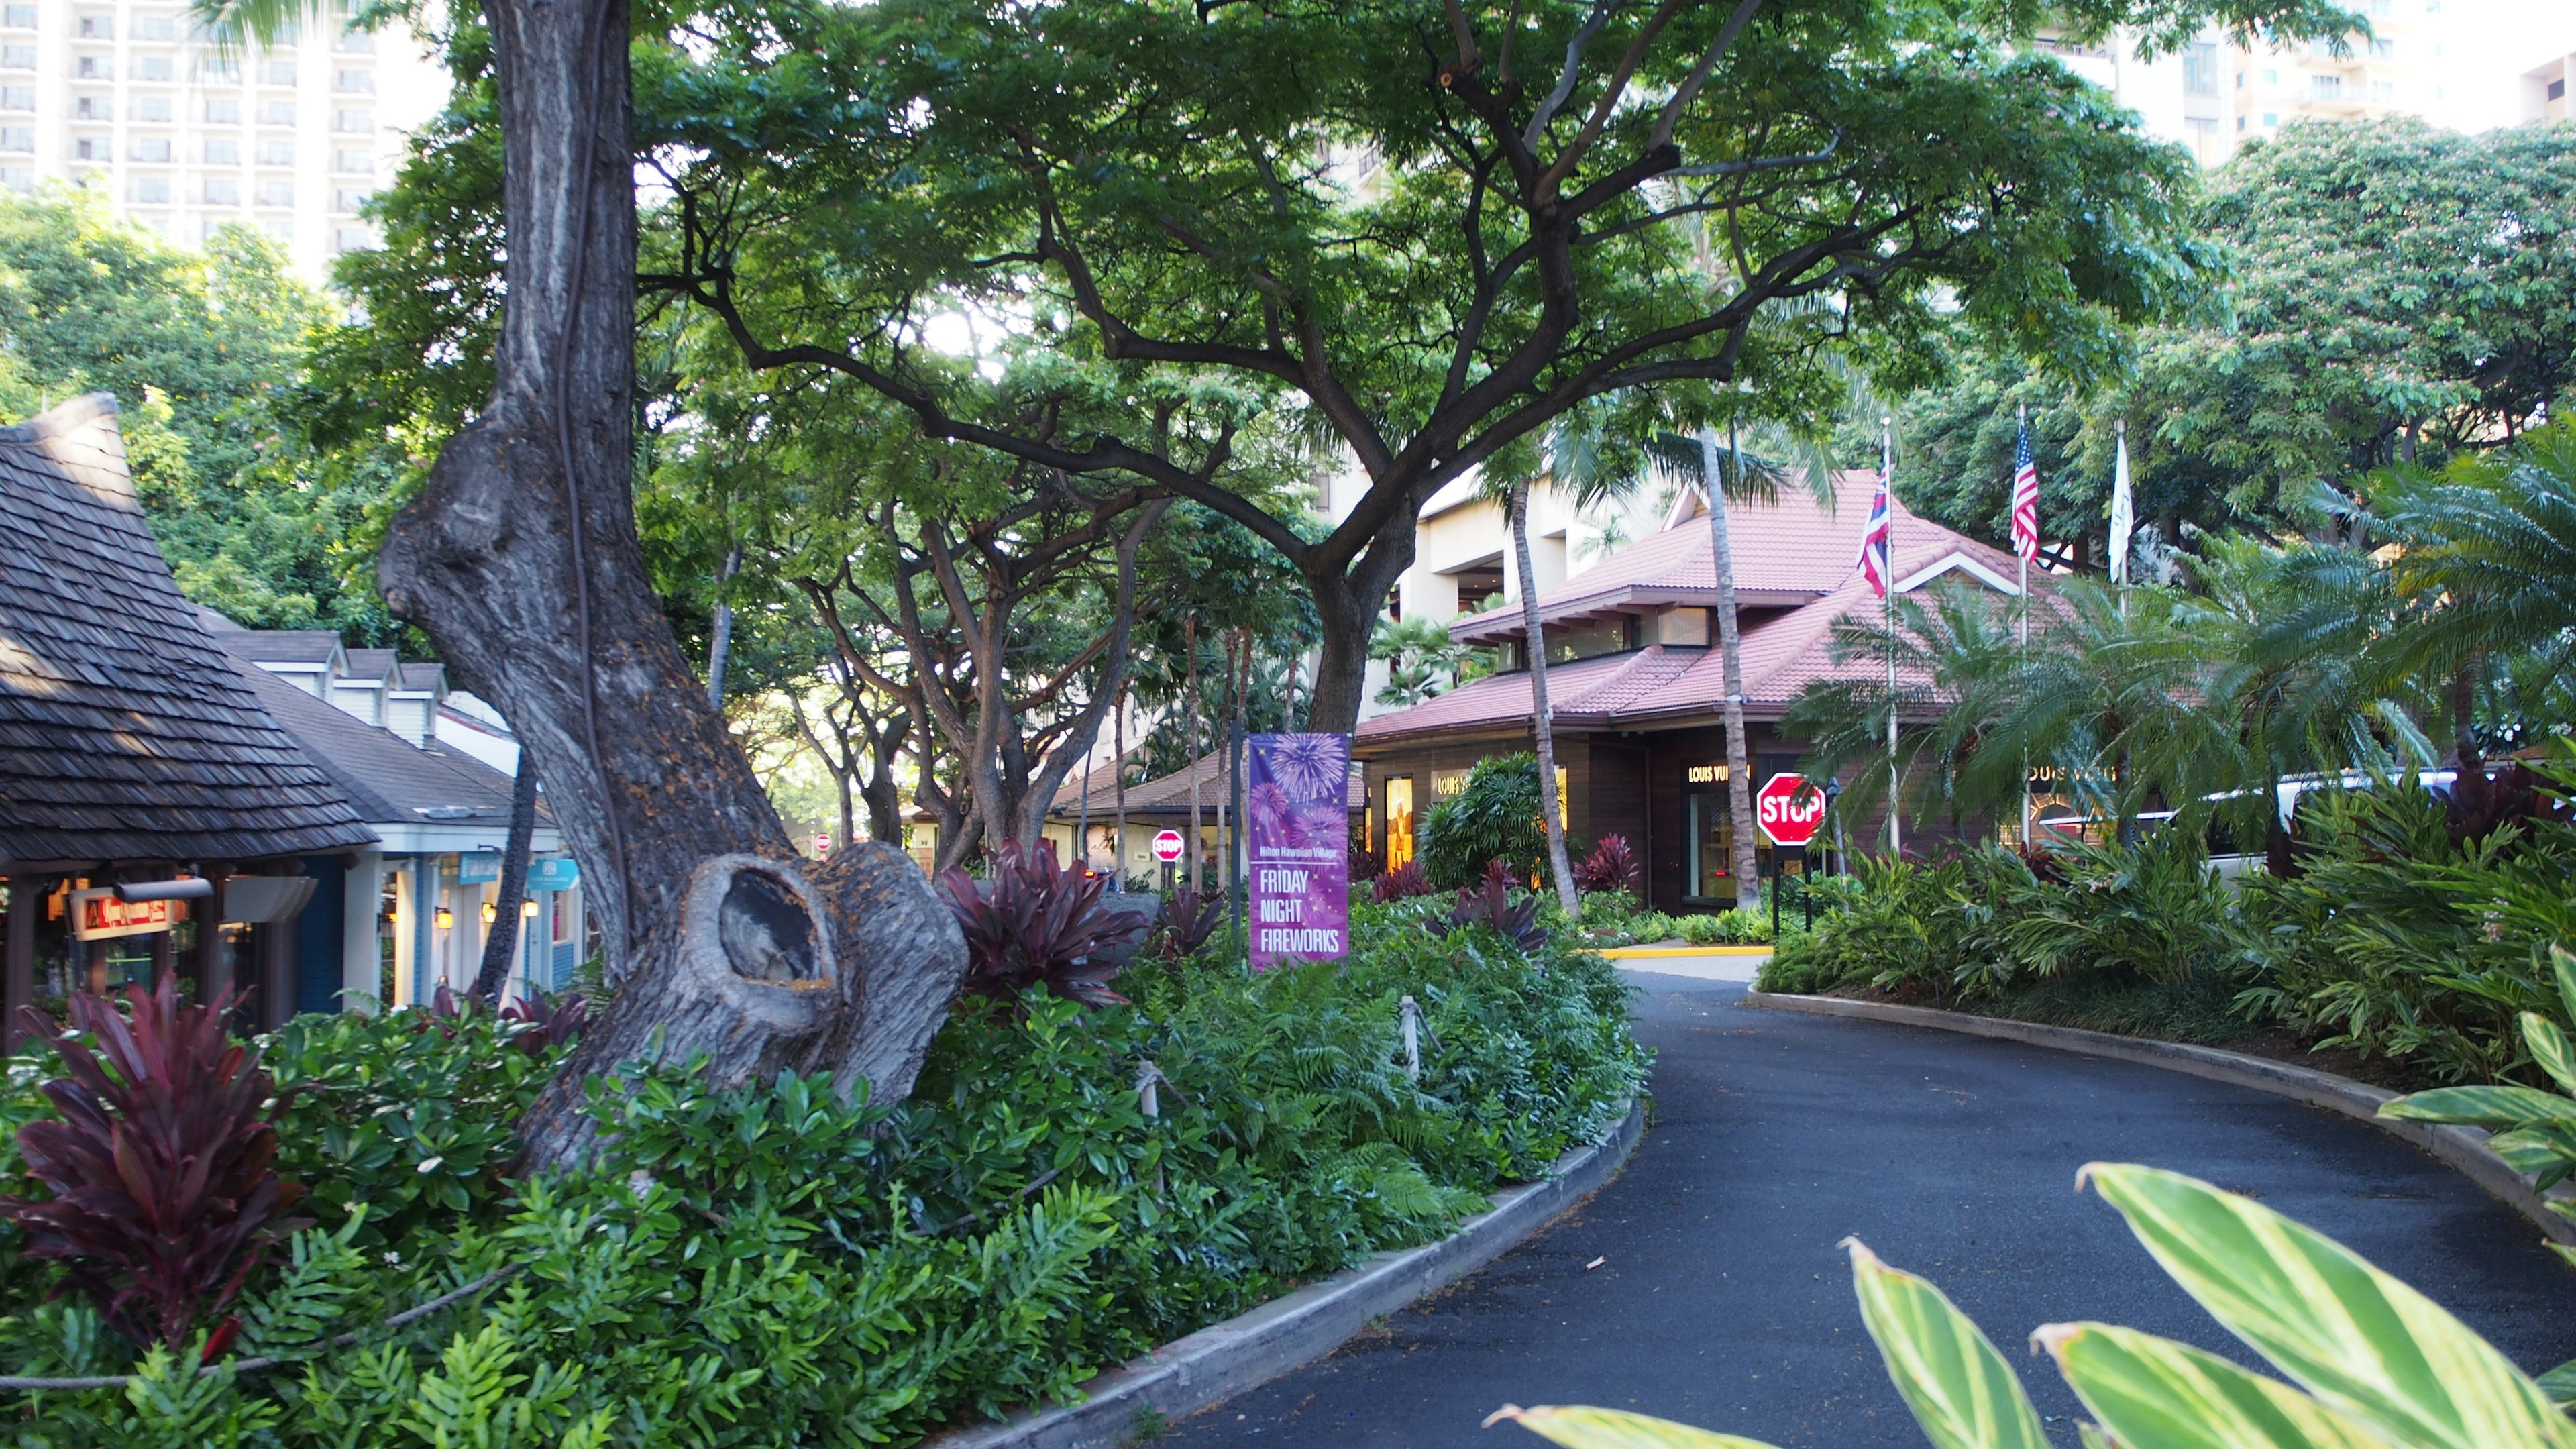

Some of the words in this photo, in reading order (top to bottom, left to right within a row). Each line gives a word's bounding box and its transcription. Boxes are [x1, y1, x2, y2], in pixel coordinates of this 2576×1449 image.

[1688, 765, 1713, 782] LOUIS
[1438, 777, 1460, 794] LOUIS
[1762, 796, 1821, 823] STOP
[1155, 839, 1181, 852] STOP
[1260, 846, 1280, 857] Hilton
[1281, 846, 1312, 857] Hawaiian
[1313, 847, 1337, 859] Village
[1260, 869, 1309, 894] FRIDAY
[1260, 899, 1303, 922] NIGHT
[1260, 928, 1339, 953] FIREWORKS
